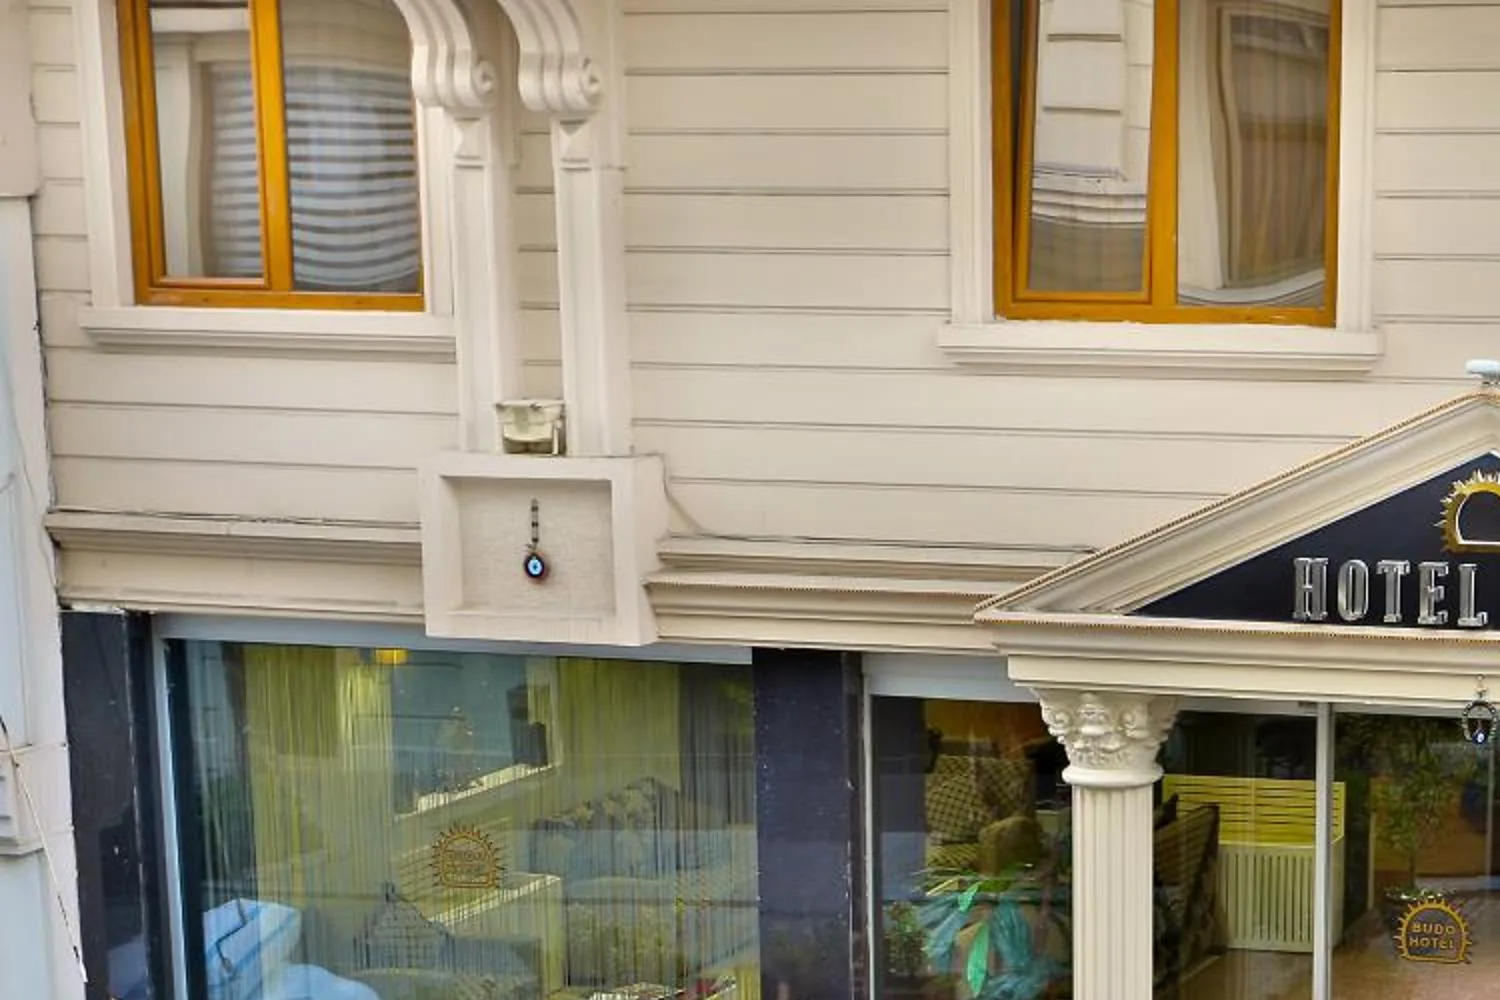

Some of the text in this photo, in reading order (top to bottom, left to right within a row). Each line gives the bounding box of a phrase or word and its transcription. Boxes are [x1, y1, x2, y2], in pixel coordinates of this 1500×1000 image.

[1292, 557, 1489, 627] HOTEL
[1411, 922, 1457, 936] BUDO
[1409, 935, 1454, 950] HOTEL
